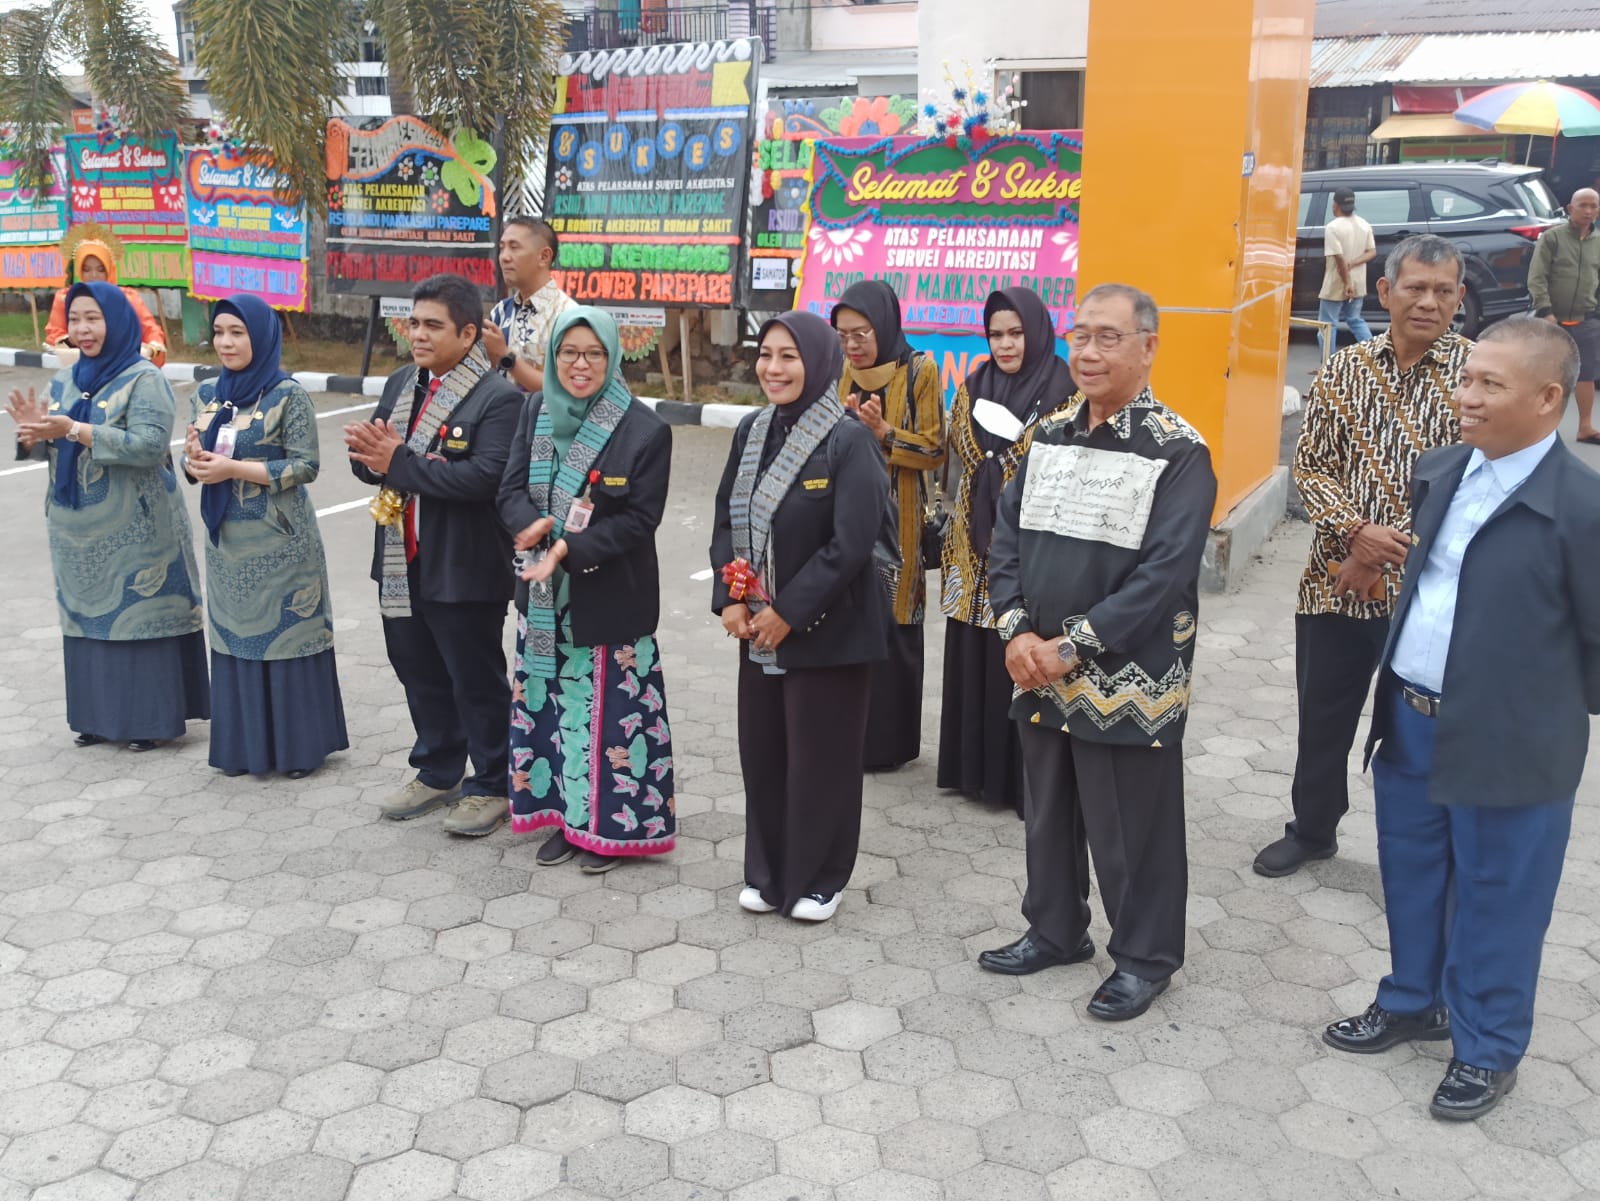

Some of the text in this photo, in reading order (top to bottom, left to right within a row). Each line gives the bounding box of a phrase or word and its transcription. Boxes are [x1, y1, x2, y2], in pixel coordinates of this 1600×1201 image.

[81, 149, 121, 169] Selamat
[122, 145, 132, 167] &
[559, 126, 735, 170] & SUKSES
[199, 163, 242, 186] Selamat
[243, 163, 253, 186] &
[655, 179, 683, 190] SURVEI
[686, 177, 735, 190] AKREDITASI
[849, 165, 967, 201] Selamat
[971, 159, 1000, 200] &
[375, 199, 426, 212] AKREDITASI
[672, 191, 724, 214] PAREPARE
[381, 214, 436, 229] MAKKASAU
[437, 216, 490, 231] PAREPARE
[567, 219, 603, 232] KOMITE
[606, 219, 660, 232] AKREDITASI
[664, 219, 700, 232] RUMAH
[702, 219, 732, 232] SAKIT
[757, 232, 783, 248] OLEH
[884, 227, 1043, 249] ATAS PELAKSANAAN
[610, 244, 731, 273] KEMBANG
[886, 249, 1036, 271] SURVEI AKREDITASI
[640, 272, 733, 304] PAREPARE
